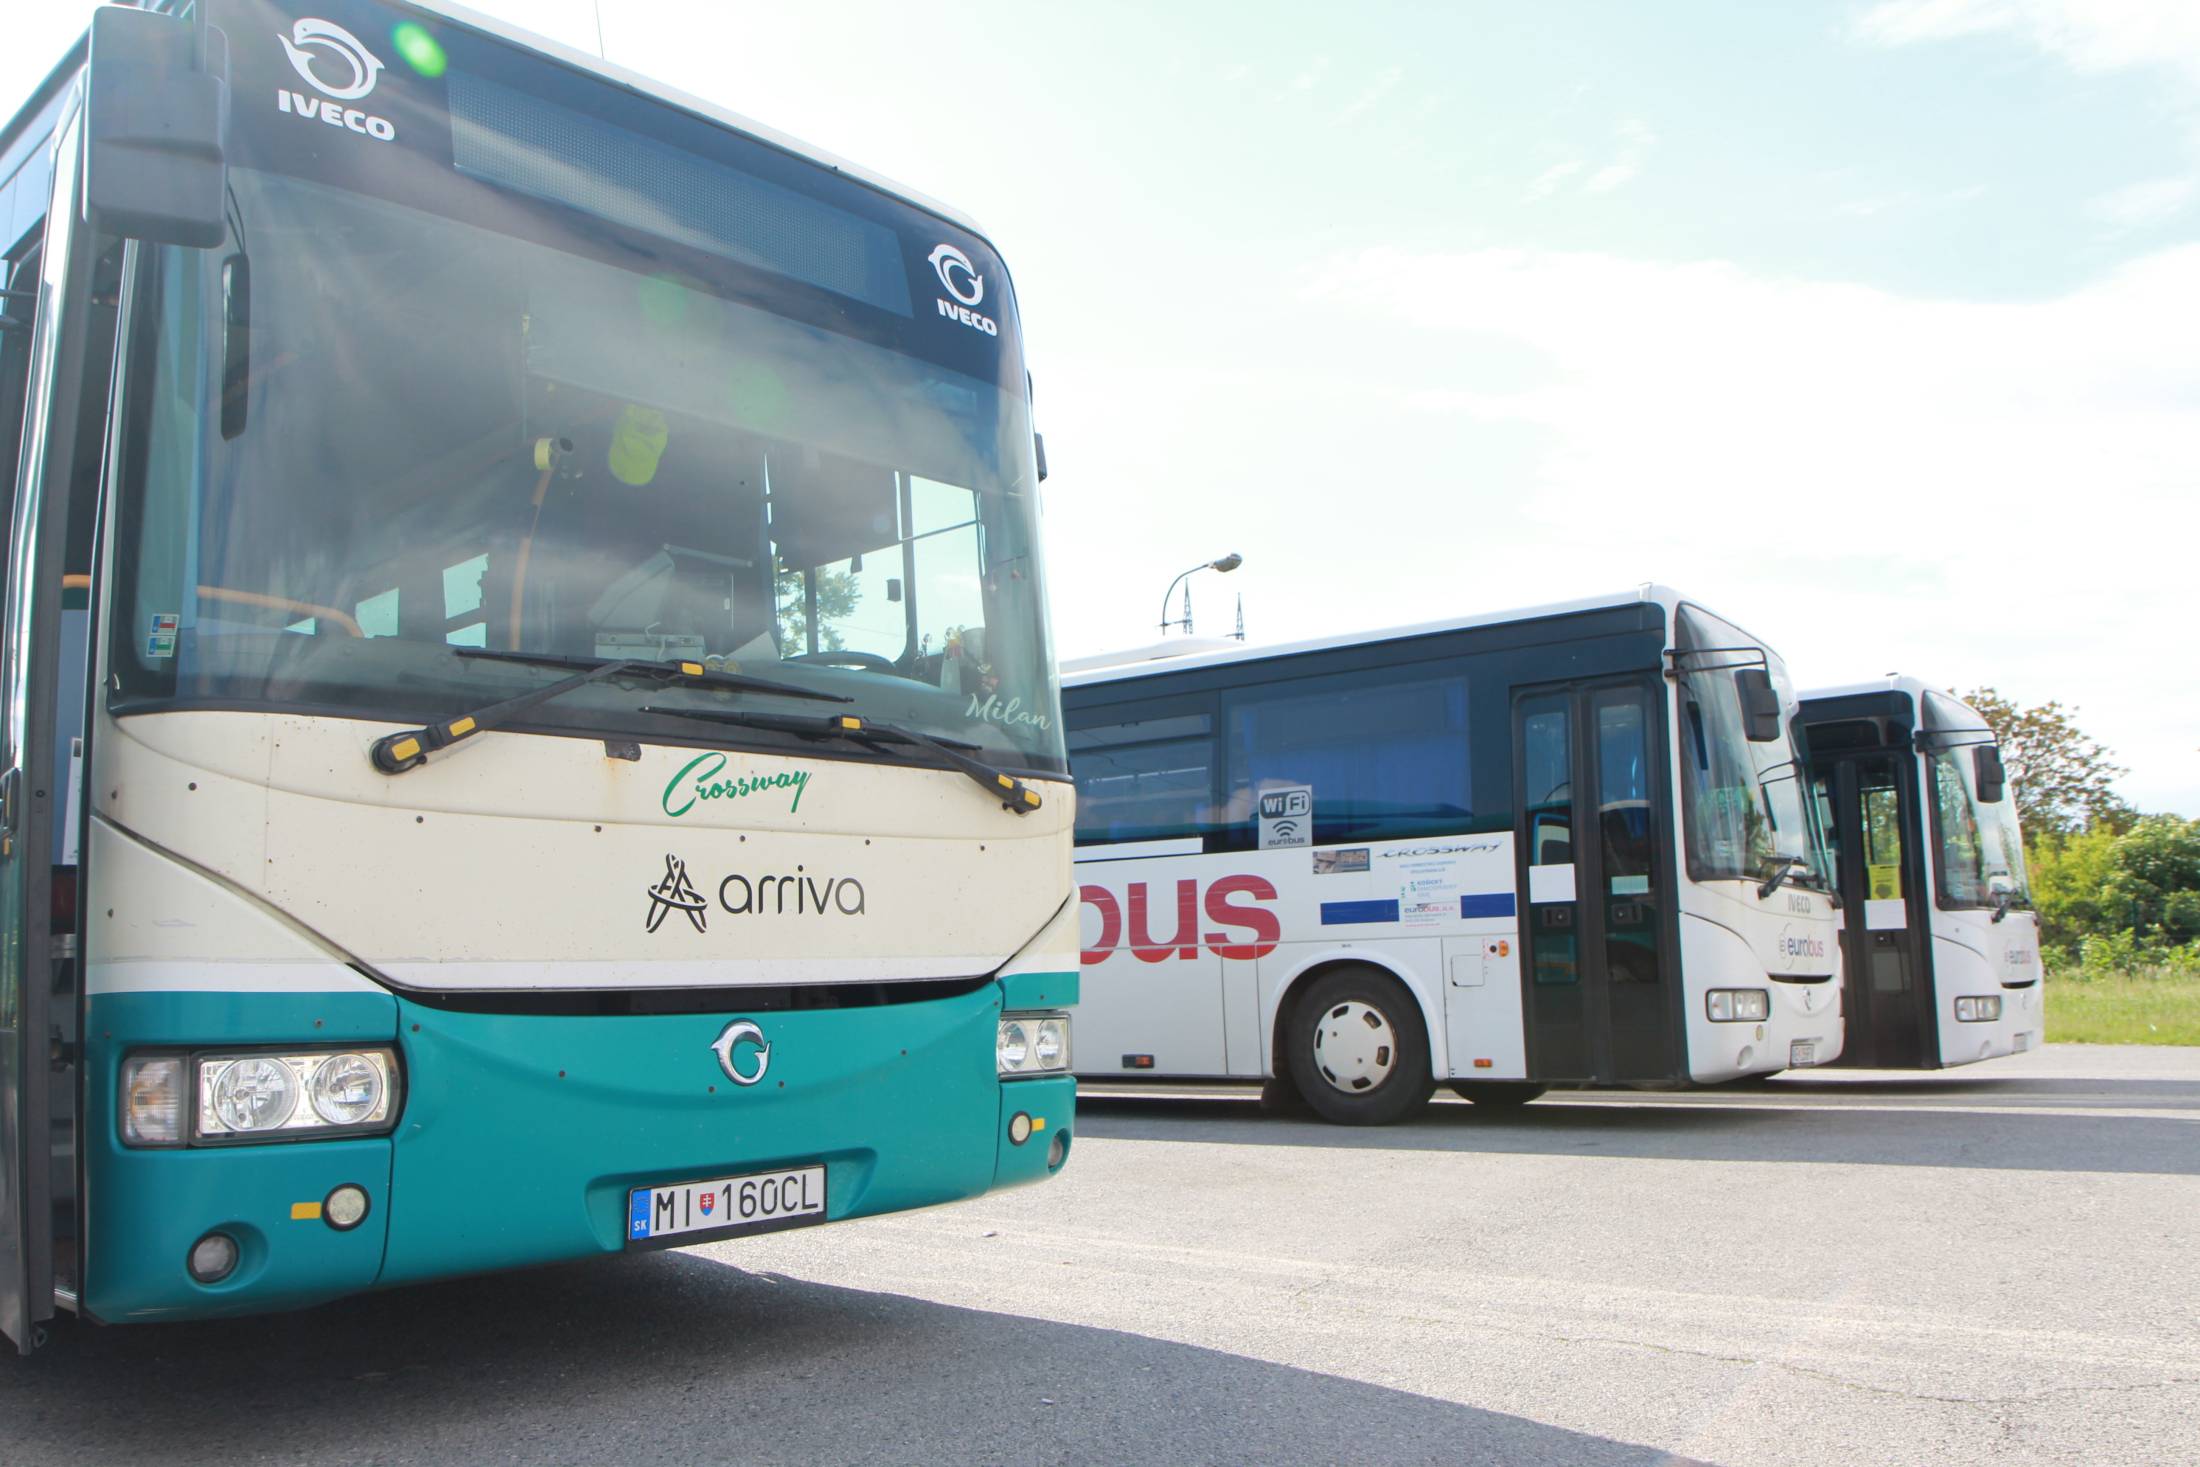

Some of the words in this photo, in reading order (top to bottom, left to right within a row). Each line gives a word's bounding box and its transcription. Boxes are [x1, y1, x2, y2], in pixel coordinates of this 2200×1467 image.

[278, 89, 396, 141] IVECO
[936, 298, 998, 337] IVECO
[965, 692, 1052, 730] Milan
[662, 752, 812, 817] Crossway
[718, 864, 865, 915] arriva
[1787, 893, 1812, 914] IVECO
[1787, 935, 1825, 957] eurobus
[655, 1188, 691, 1232] MI
[721, 1173, 819, 1221] 160CL
[633, 1219, 648, 1232] SK
